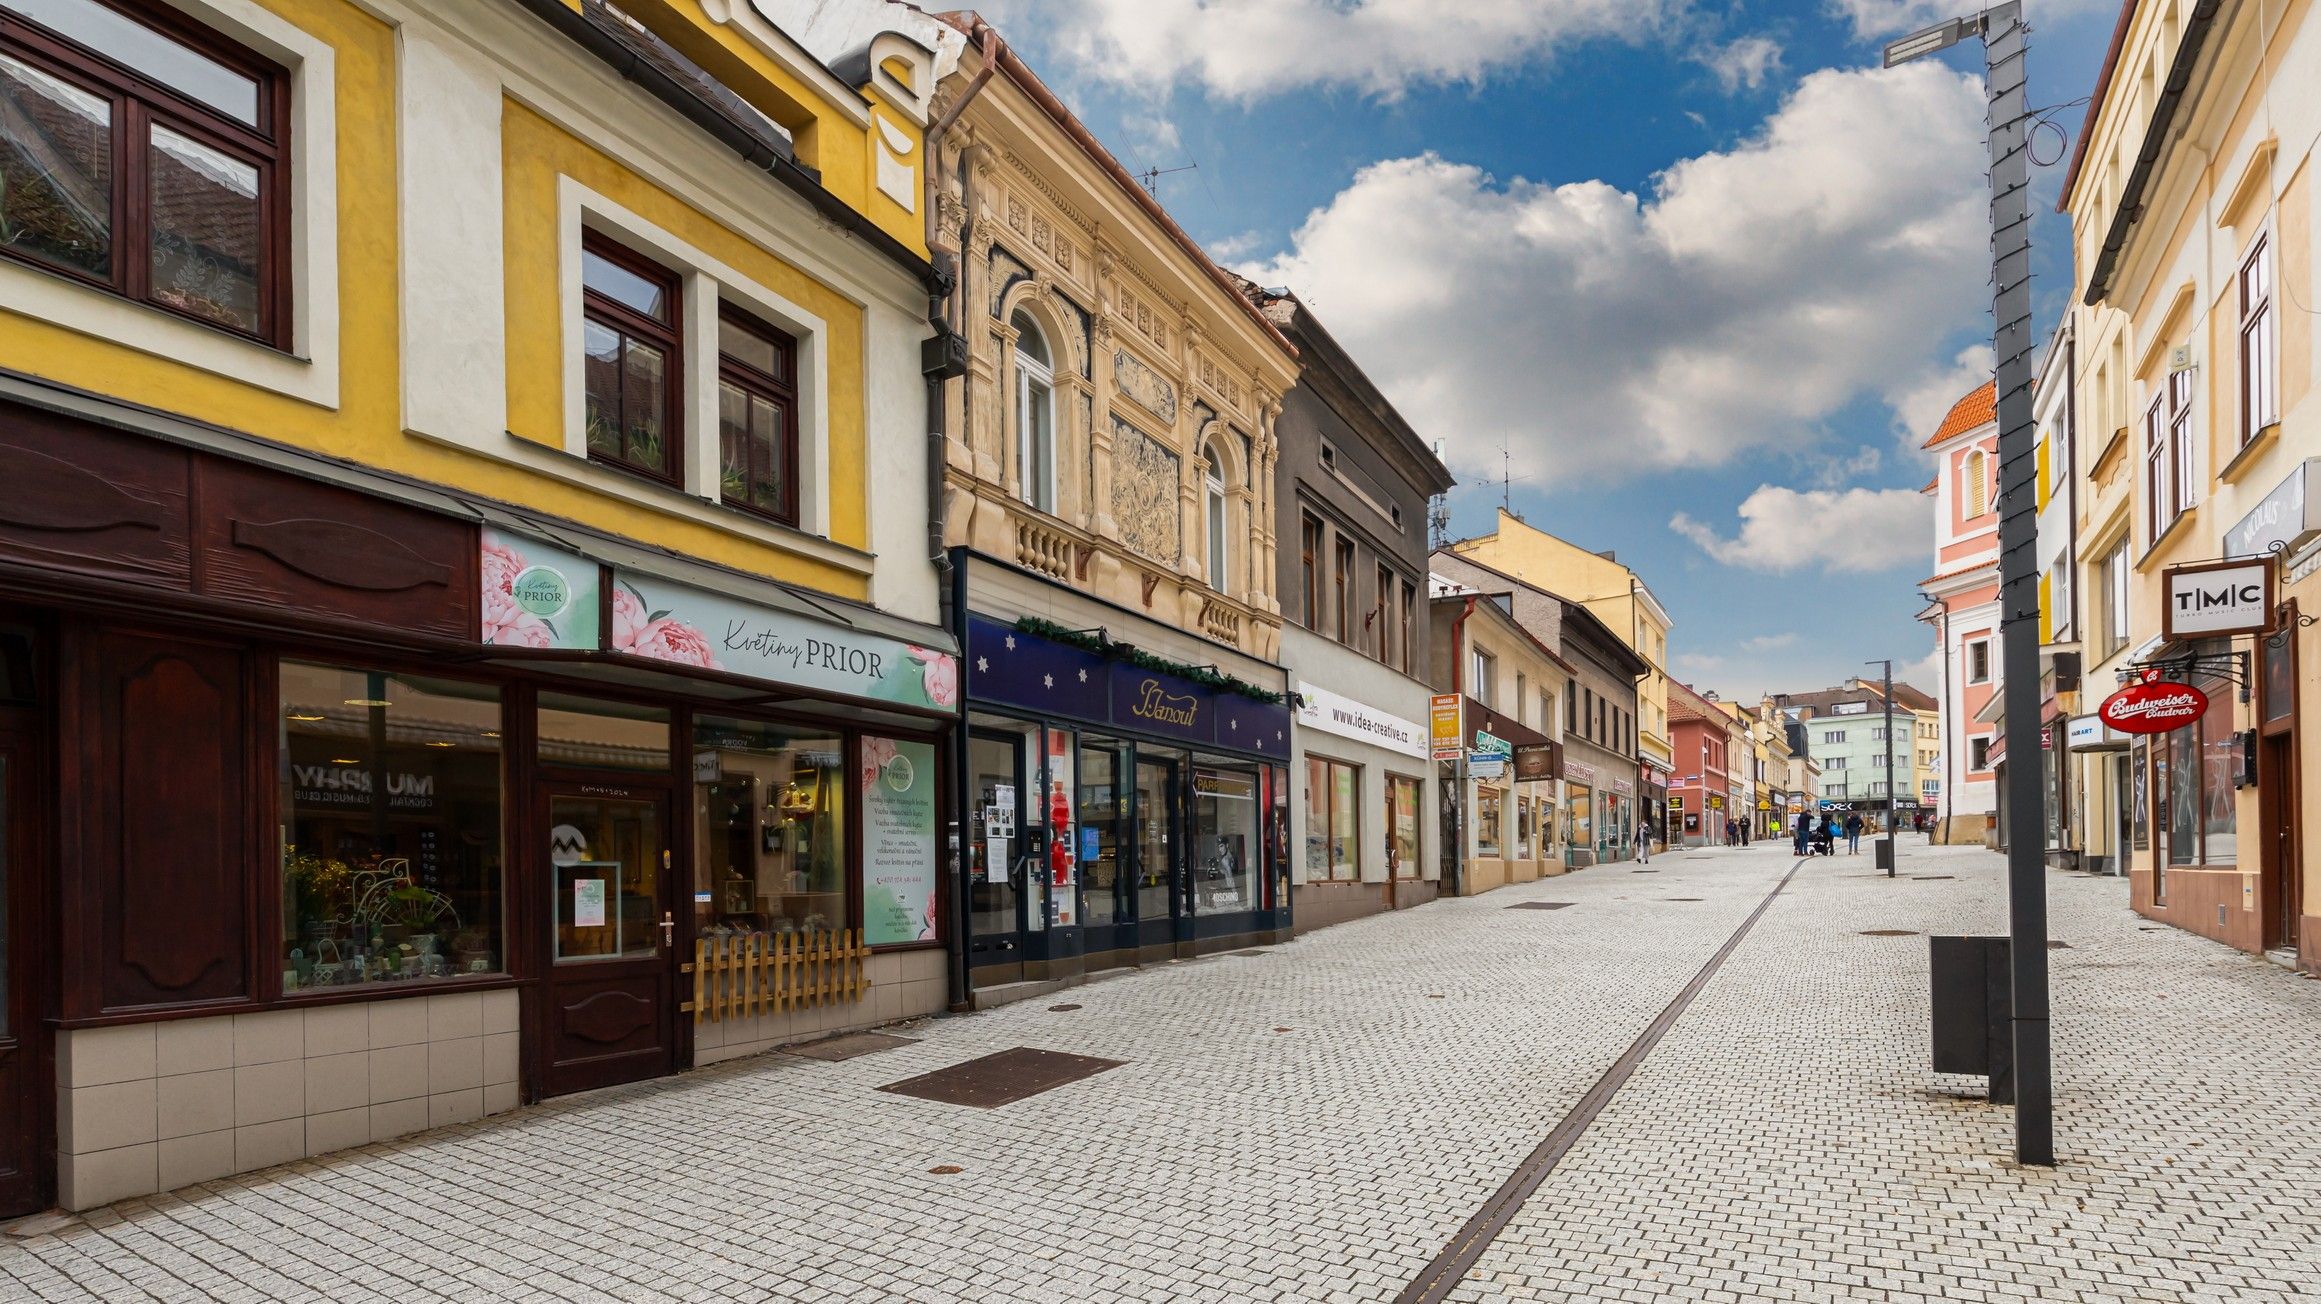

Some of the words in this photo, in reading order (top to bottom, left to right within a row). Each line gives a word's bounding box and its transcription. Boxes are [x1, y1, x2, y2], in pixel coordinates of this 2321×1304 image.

[524, 592, 562, 602] PRIOR
[723, 619, 803, 669] Květiny
[806, 638, 884, 679] PRIOR
[2107, 693, 2198, 718] Budweiser
[2145, 707, 2195, 719] Budvar
[1332, 708, 1408, 743] www.idea-creative.cz
